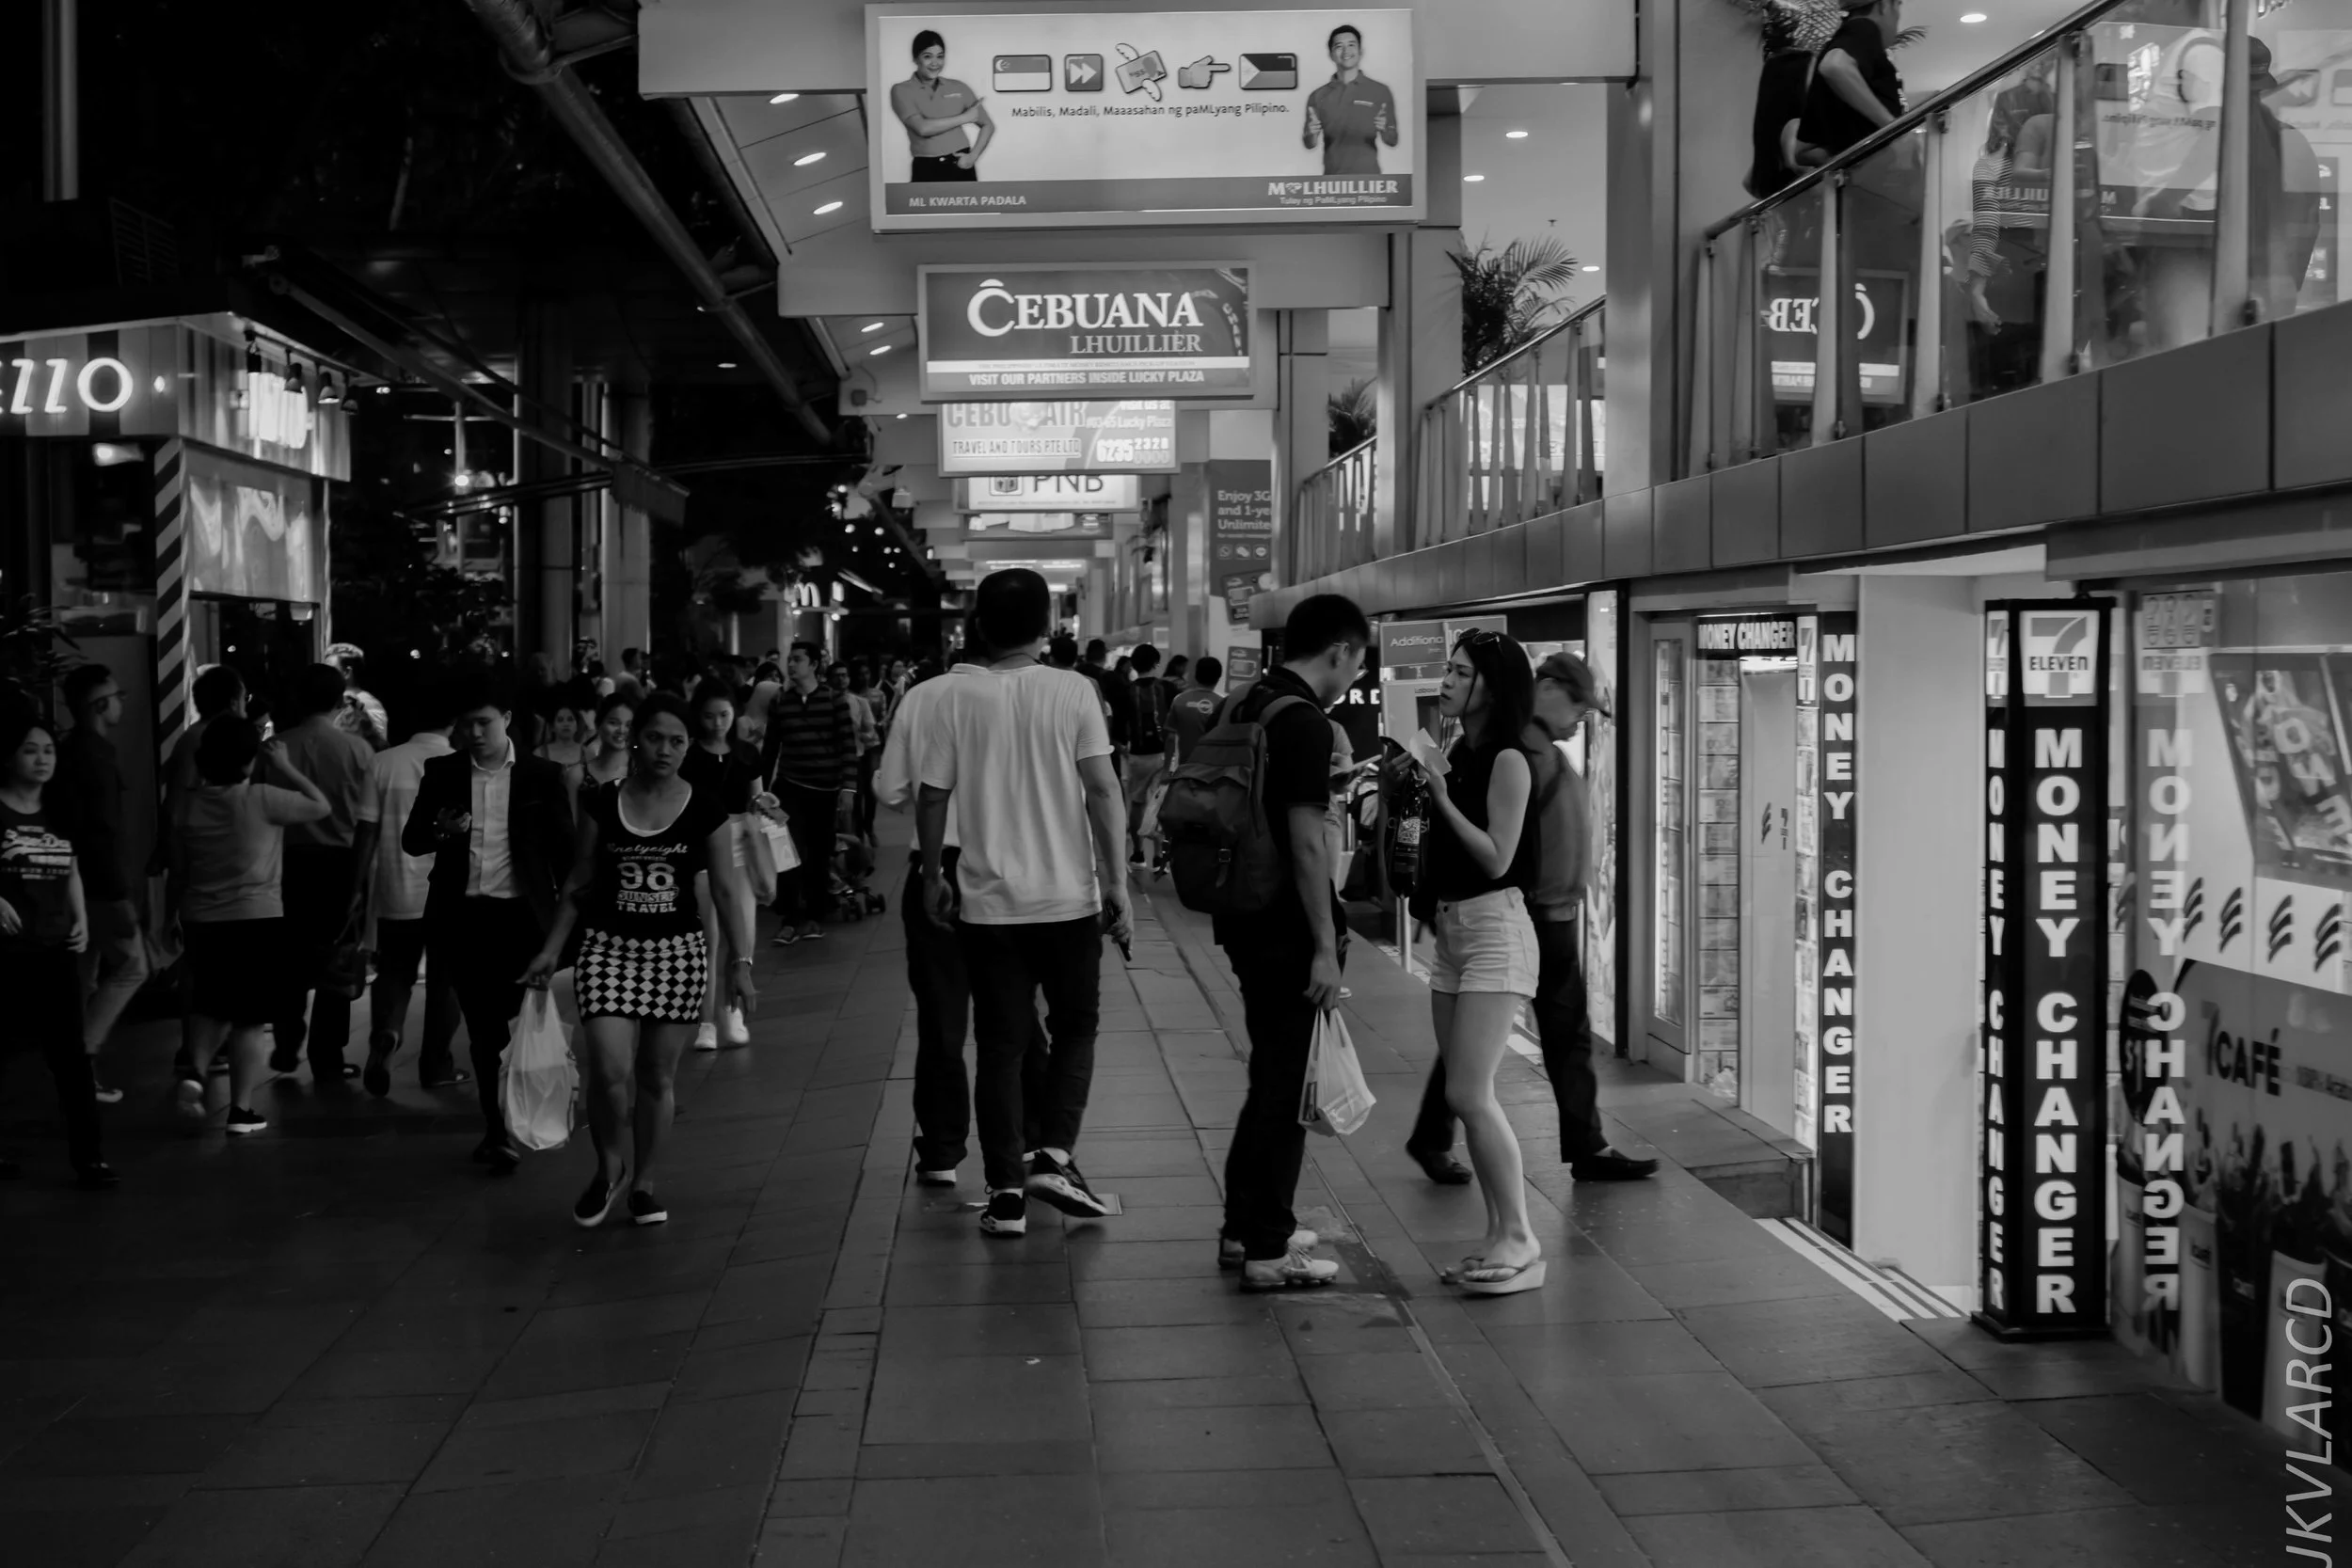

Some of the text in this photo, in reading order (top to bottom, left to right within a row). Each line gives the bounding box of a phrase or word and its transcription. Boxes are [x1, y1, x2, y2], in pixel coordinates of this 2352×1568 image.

[1011, 102, 1290, 119] Mabilis, Madali, Maaasahan ng paMLyang Pilipino.
[909, 196, 1026, 207] ML KWARTA PADALA
[967, 277, 1205, 337] CEBUANA
[1070, 333, 1204, 355] LHUILLIER
[969, 370, 1205, 385] VISIT OUR PARTNERS INSIDE LUCKY PLAZA
[952, 439, 987, 455] TRAVEL
[989, 439, 1010, 454] AND
[1011, 438, 1042, 454] TOURS
[1217, 489, 1252, 504] Enjoy
[1217, 505, 1242, 515] and
[1698, 621, 1796, 650] MONEY CHANGER
[616, 862, 676, 891] 98
[1822, 633, 1855, 1133] MONEY CHANGER
[616, 900, 677, 914] TRAVEL
[1987, 728, 2006, 1310] MONEY CHANGER
[2033, 727, 2083, 1314] MONEY CHANGER
